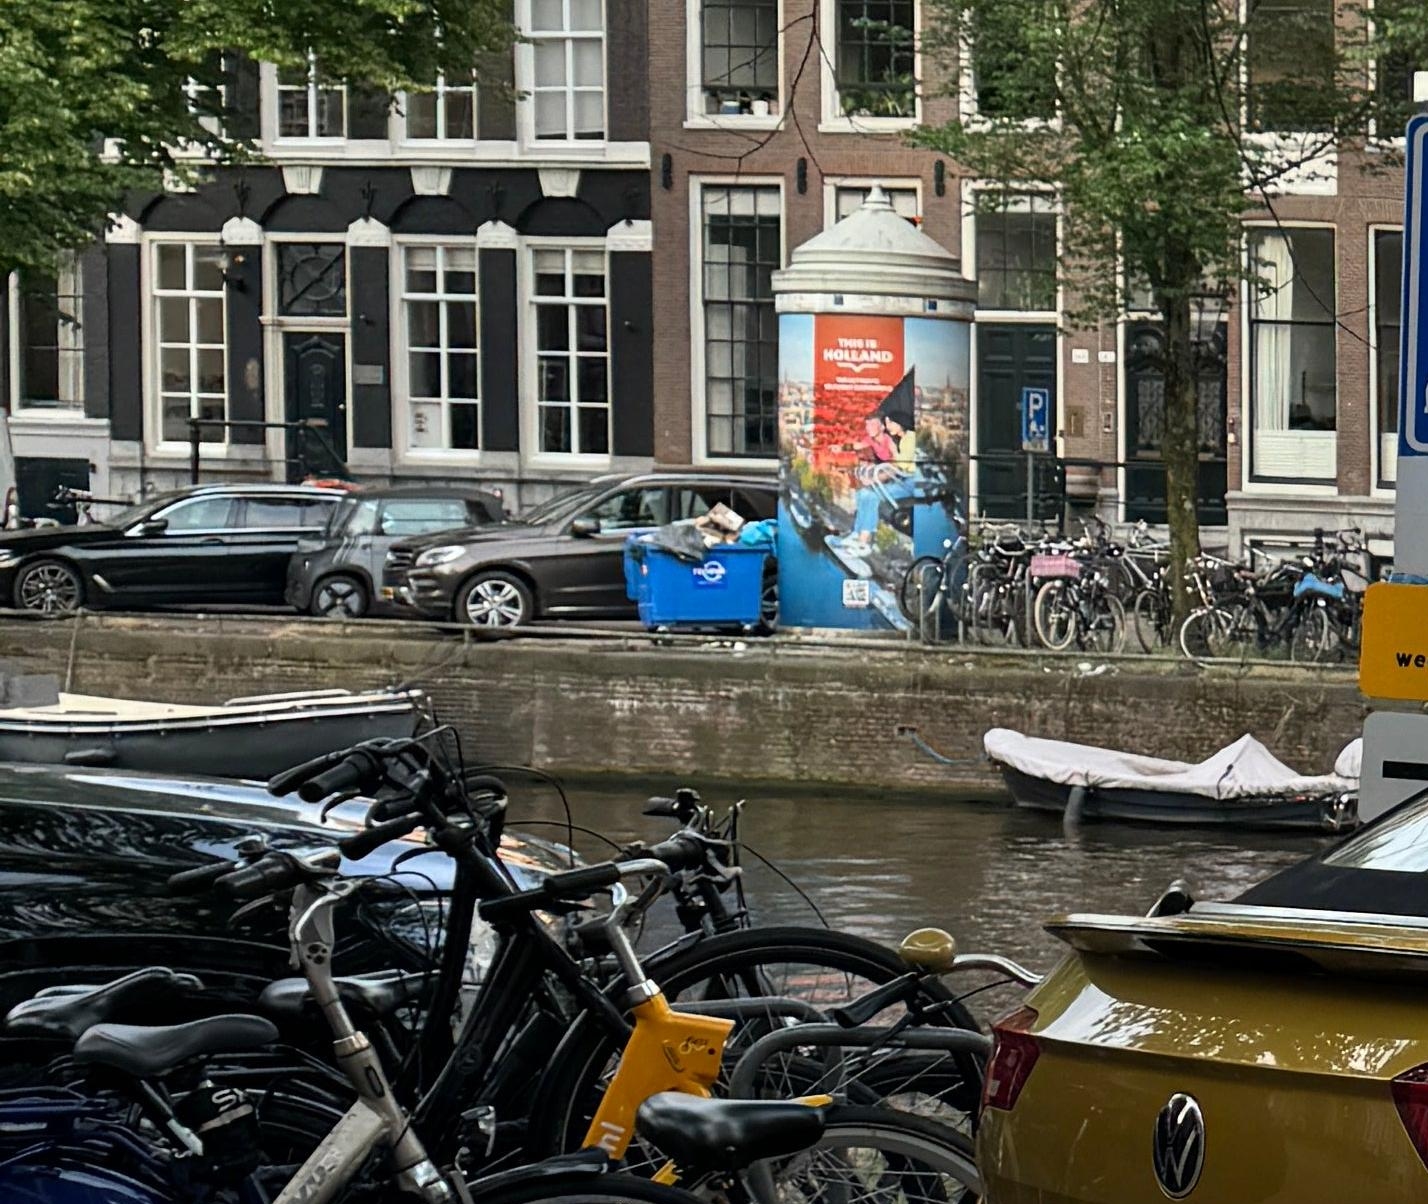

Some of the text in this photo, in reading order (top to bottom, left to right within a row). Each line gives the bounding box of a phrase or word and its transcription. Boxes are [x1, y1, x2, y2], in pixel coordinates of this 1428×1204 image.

[838, 337, 877, 349] THIS IS
[823, 348, 894, 363] HOLLAND
[1029, 393, 1043, 419] P
